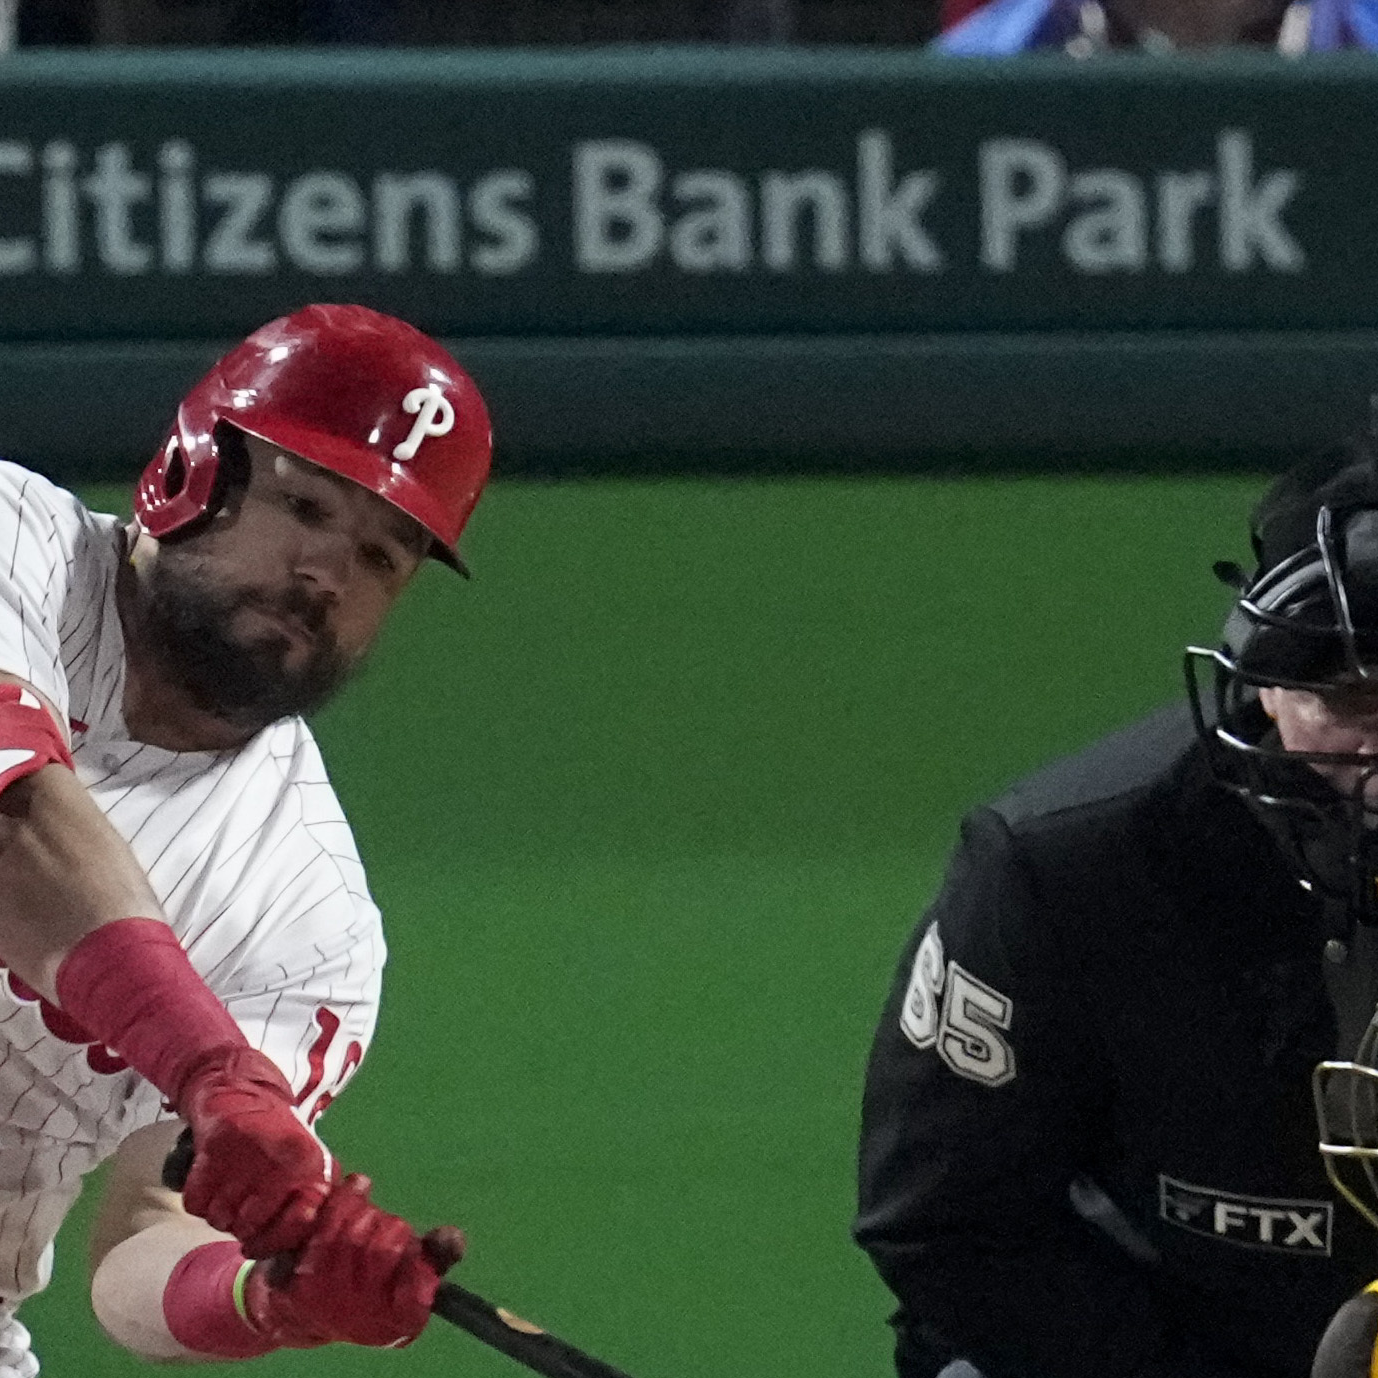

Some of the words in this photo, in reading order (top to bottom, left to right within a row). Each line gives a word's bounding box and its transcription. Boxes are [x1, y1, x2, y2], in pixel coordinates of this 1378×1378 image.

[573, 131, 940, 271] Bank
[979, 131, 1303, 272] Park
[392, 383, 455, 461] P
[900, 920, 1017, 1088] 65
[1215, 1201, 1324, 1248] FTX
